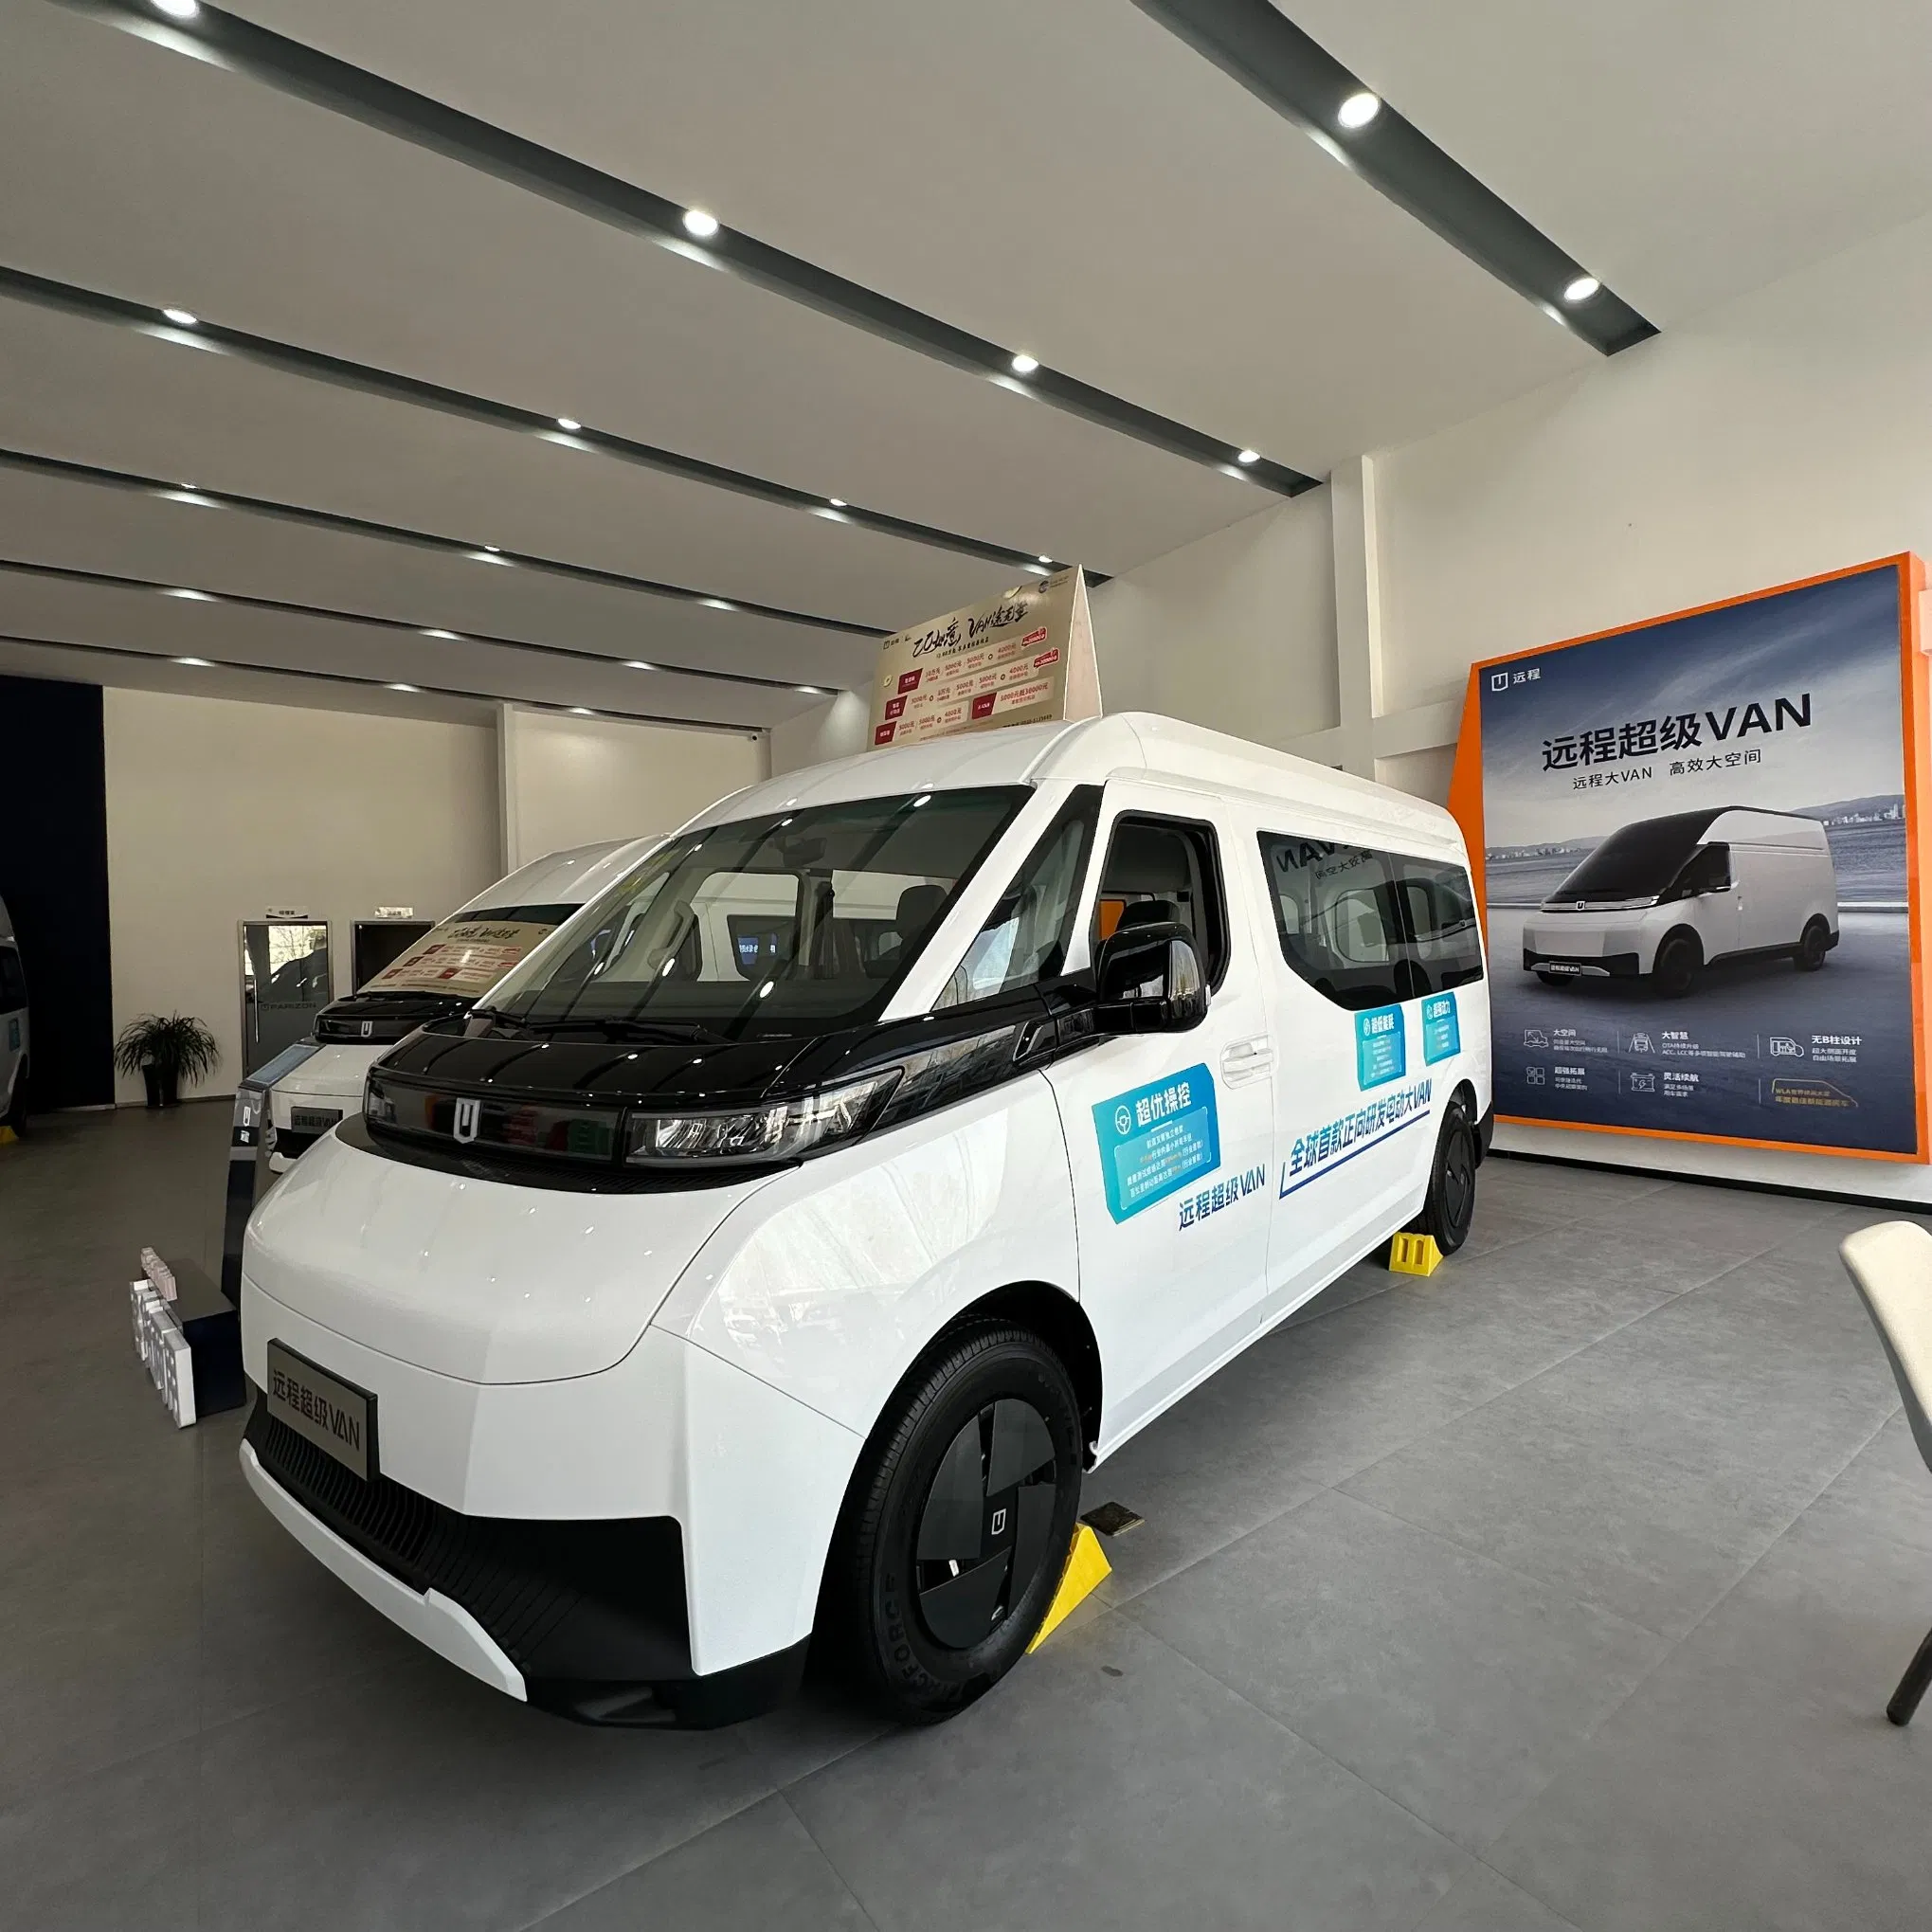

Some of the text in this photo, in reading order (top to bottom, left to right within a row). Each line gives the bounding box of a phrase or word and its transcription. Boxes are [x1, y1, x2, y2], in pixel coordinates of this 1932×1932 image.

[1513, 667, 1541, 684] 远程
[1542, 693, 1812, 771] 远程超级VAN
[1573, 749, 1761, 790] 远程大VAN 高效大空间
[1371, 1013, 1395, 1034] 超低能耗
[1662, 1031, 1688, 1039] 大智慧
[1812, 1035, 1862, 1045] 无B柱设计
[1554, 1066, 1585, 1075] 超强拓展
[1663, 1072, 1700, 1082] 灵活续航
[1135, 1081, 1192, 1128] 超优操控
[1289, 1078, 1432, 1177] 全球首款正向研发电动大VAN
[1179, 1164, 1266, 1231] 远程超级VAN
[273, 1368, 360, 1452] 远程超级VAN
